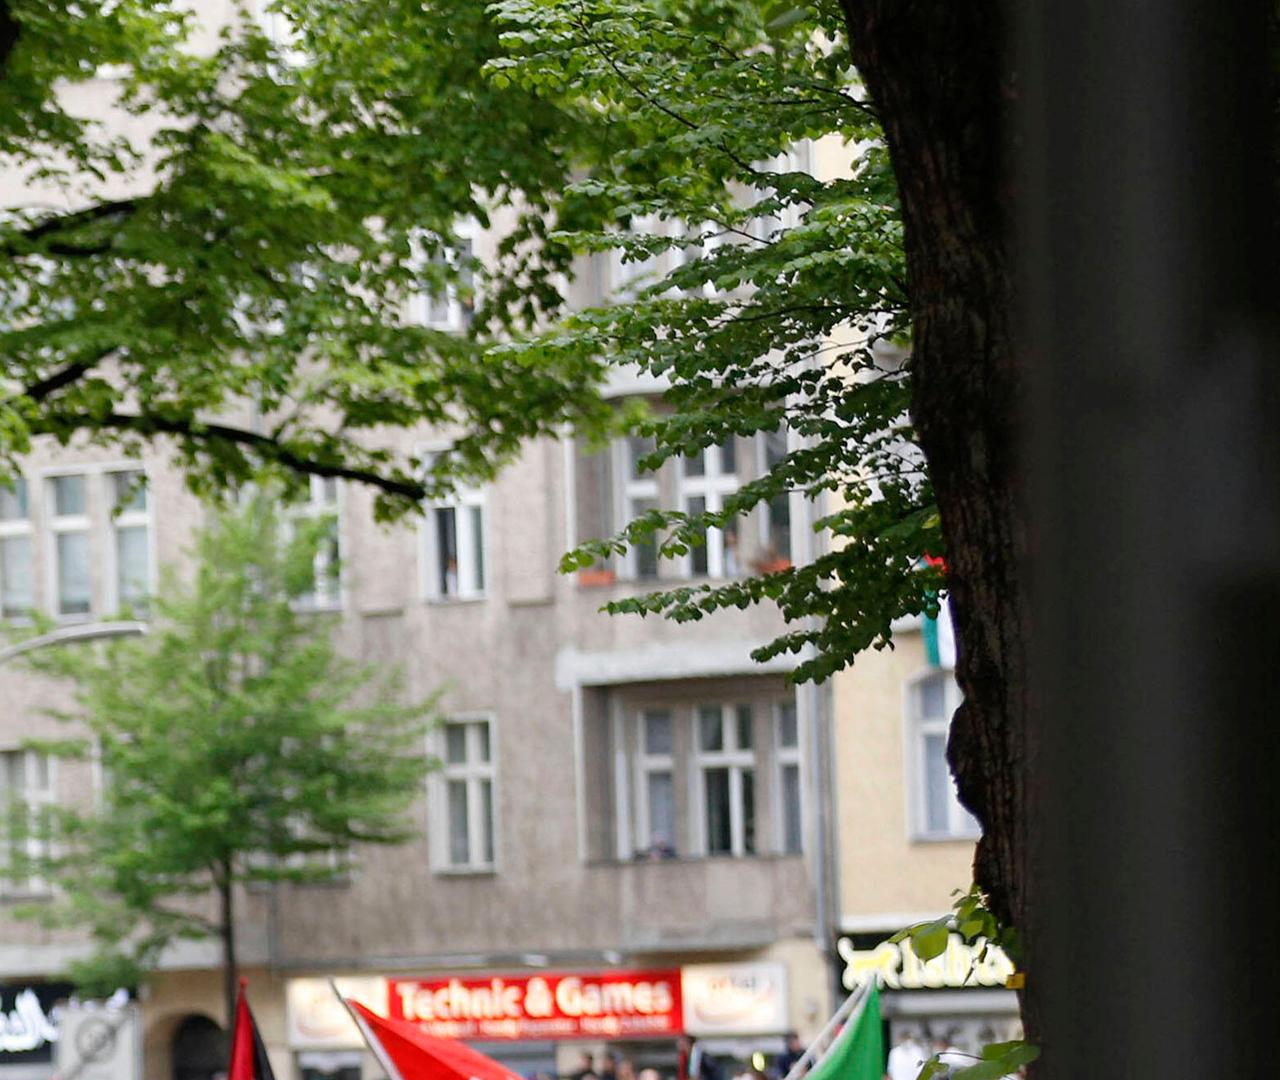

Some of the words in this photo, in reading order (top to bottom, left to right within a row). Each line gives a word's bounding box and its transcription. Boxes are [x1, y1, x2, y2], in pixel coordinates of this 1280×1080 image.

[395, 977, 522, 1020] Technic
[525, 976, 553, 1018] &
[556, 975, 673, 1017] Games
